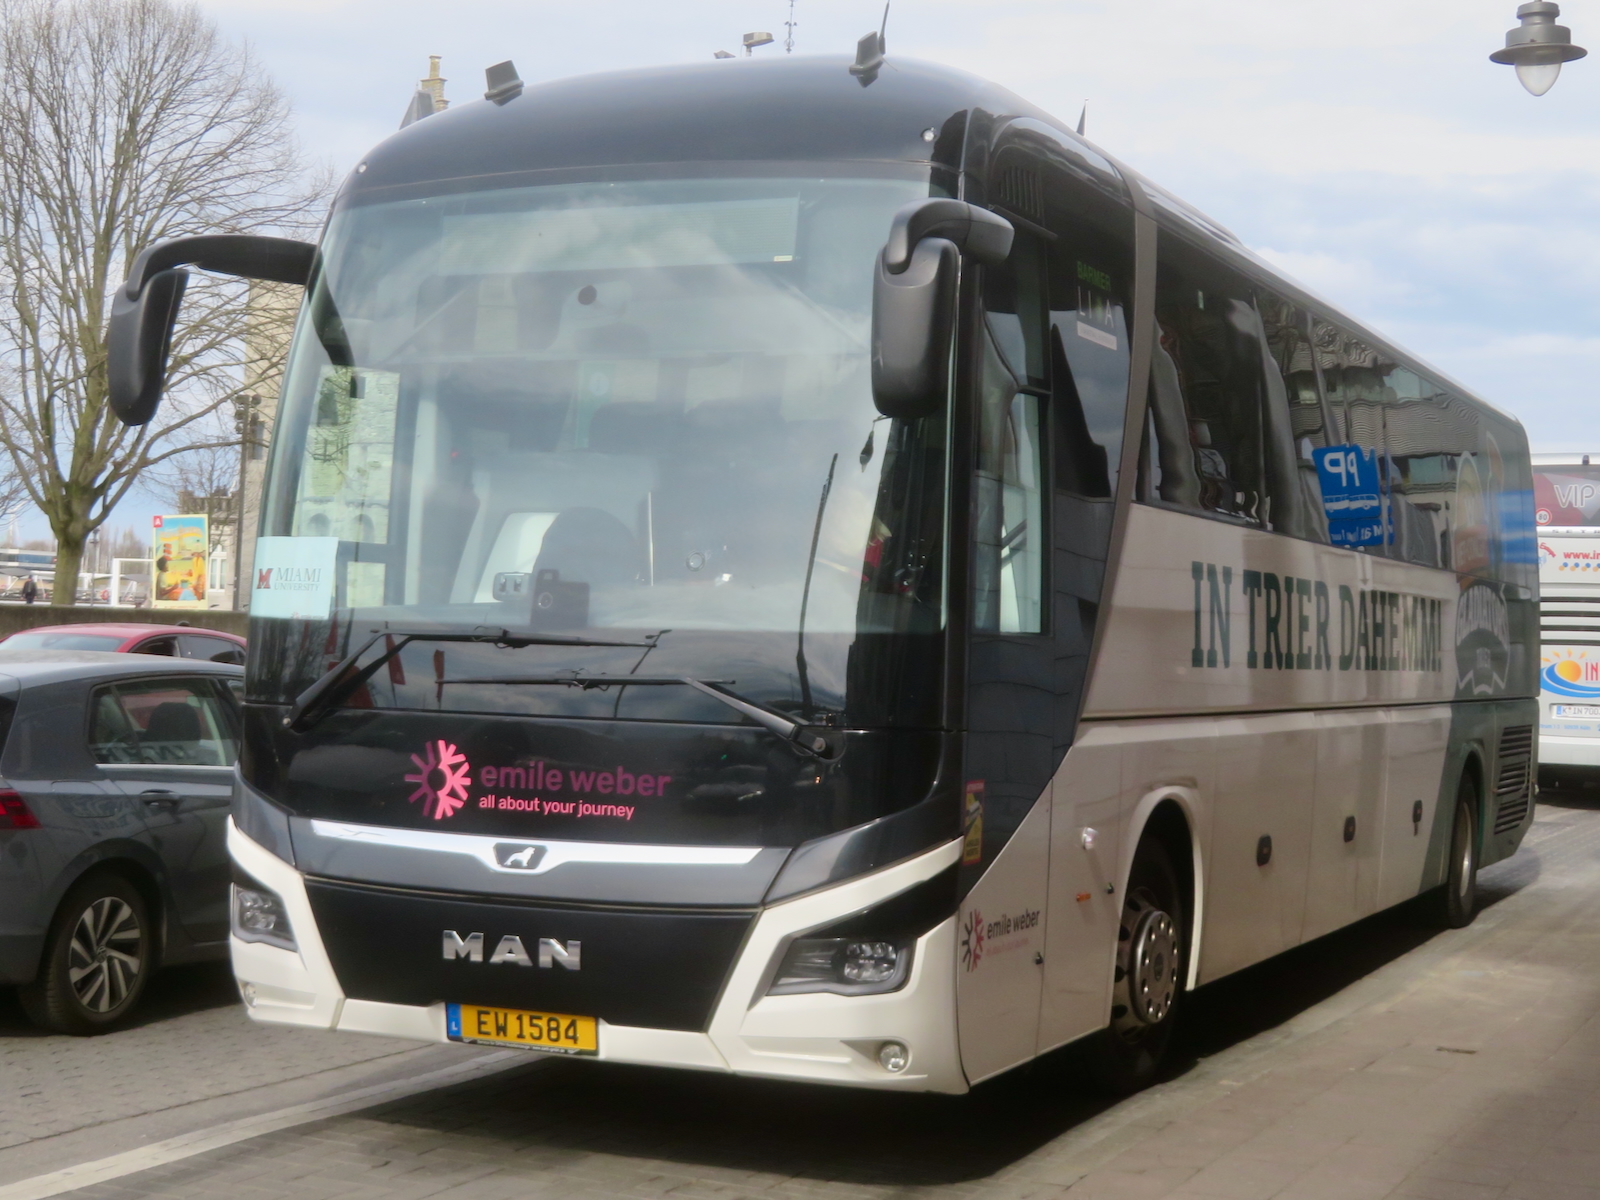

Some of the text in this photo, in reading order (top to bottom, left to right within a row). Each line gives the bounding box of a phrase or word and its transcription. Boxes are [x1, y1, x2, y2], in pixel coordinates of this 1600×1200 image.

[154, 517, 162, 526] A
[1538, 513, 1548, 521] 80
[275, 567, 321, 582] MIAMI
[274, 582, 320, 592] UNIVERSITY
[1192, 561, 1232, 668] IN
[1243, 569, 1331, 671] TRIER
[481, 761, 671, 797] emile weber
[479, 795, 635, 820] all about your journey
[987, 908, 1041, 940] emile weber
[443, 930, 581, 971] MAN
[451, 1021, 458, 1031] L
